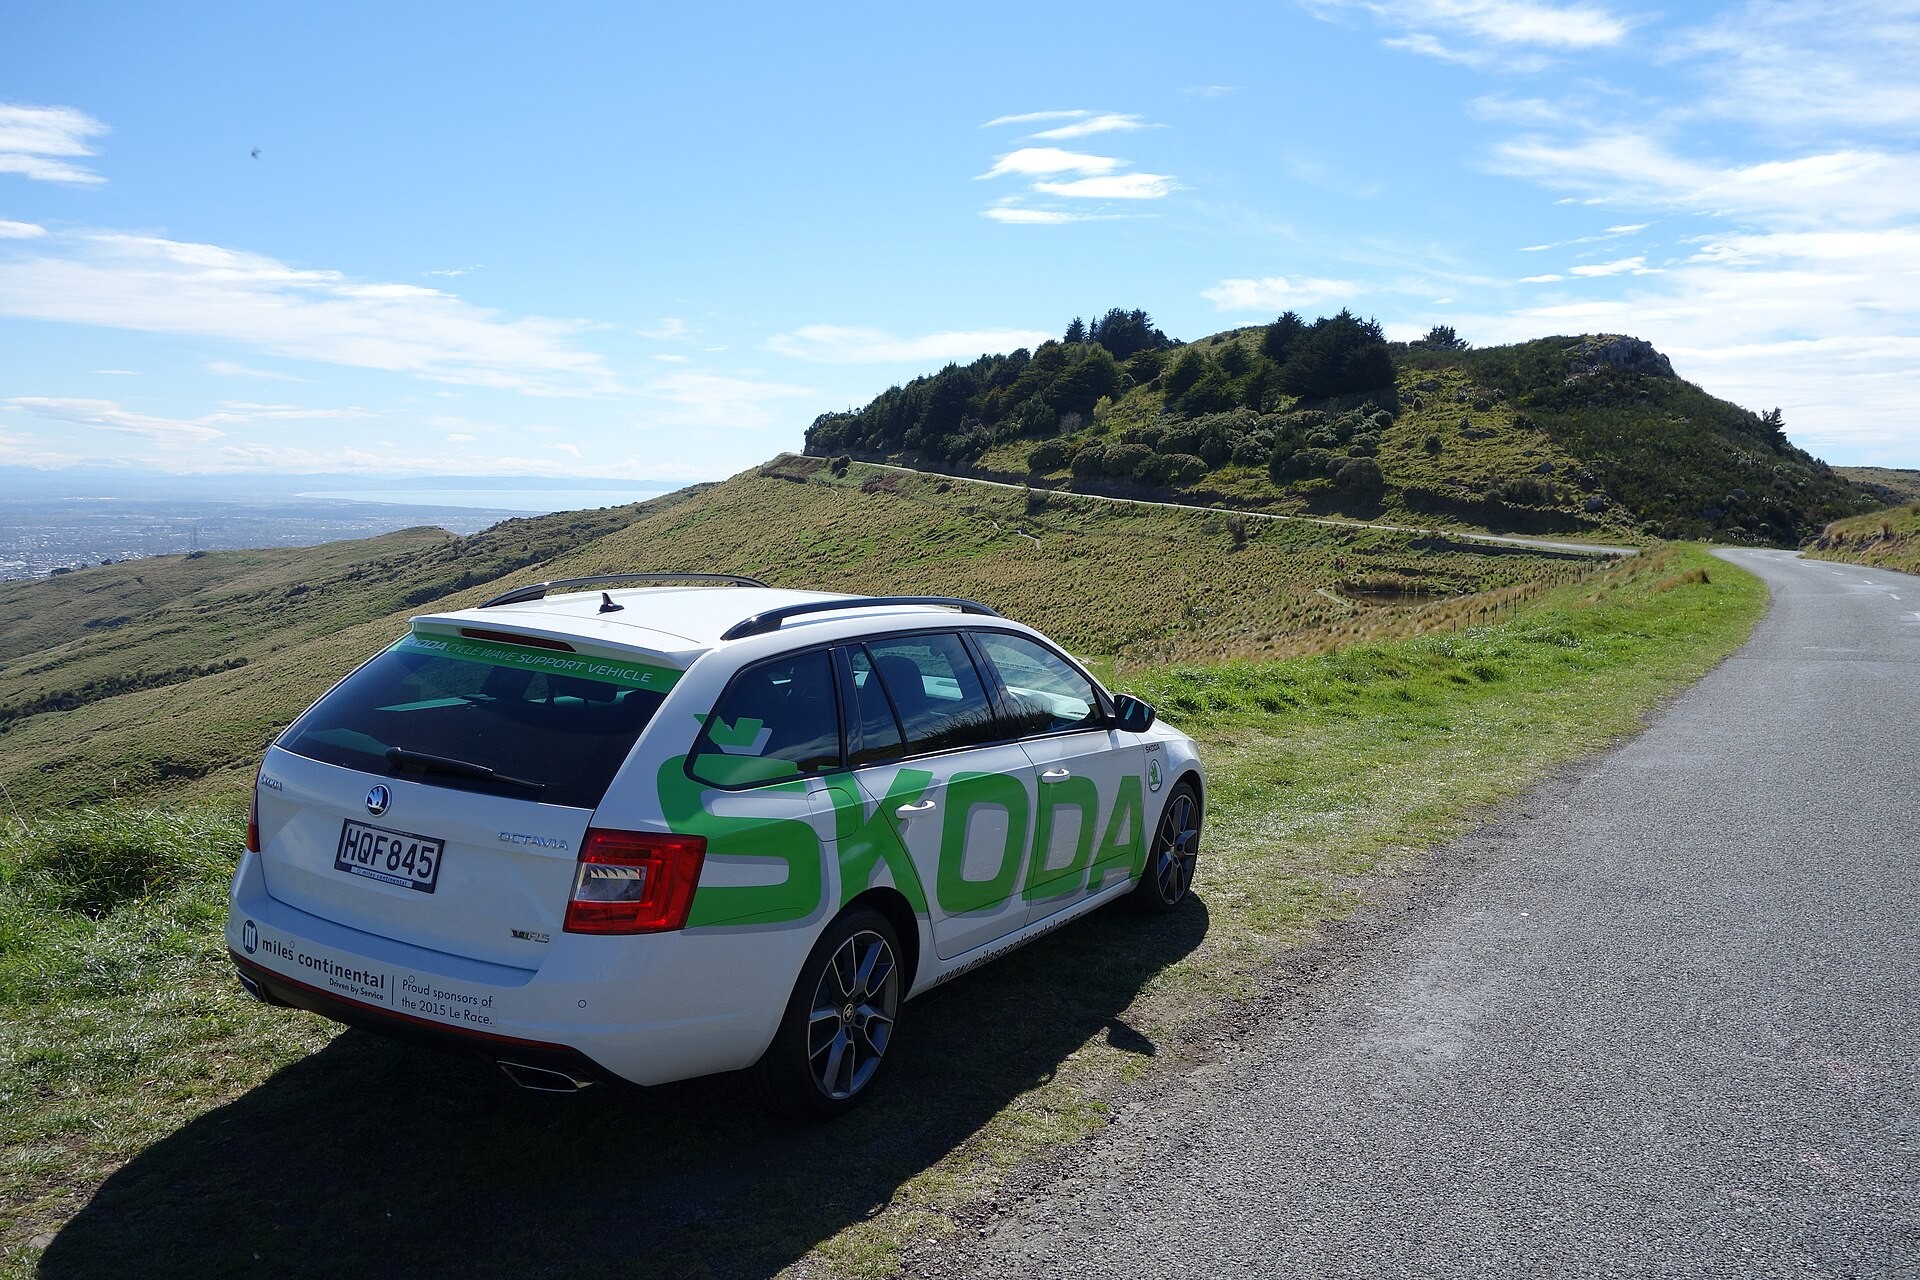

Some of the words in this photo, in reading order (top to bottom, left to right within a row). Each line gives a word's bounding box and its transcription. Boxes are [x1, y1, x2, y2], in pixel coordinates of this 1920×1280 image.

[446, 643, 482, 656] CYCLE
[480, 648, 518, 661] WAVE
[516, 654, 586, 671] SUPPORT
[588, 663, 653, 683] VEHICLE
[343, 828, 433, 879] HQF845
[498, 832, 568, 851] OCTAVIA
[262, 939, 293, 961] miles
[298, 954, 385, 989] continental
[329, 978, 349, 991] Driven
[350, 985, 359, 996] by
[360, 987, 384, 1001] Service
[402, 979, 430, 996] Proud
[433, 989, 478, 1005] sponsors
[481, 996, 493, 1007] of
[401, 996, 416, 1010] the
[419, 1000, 446, 1016] 2015
[449, 1006, 460, 1019] Le
[464, 1009, 493, 1025] Race.
